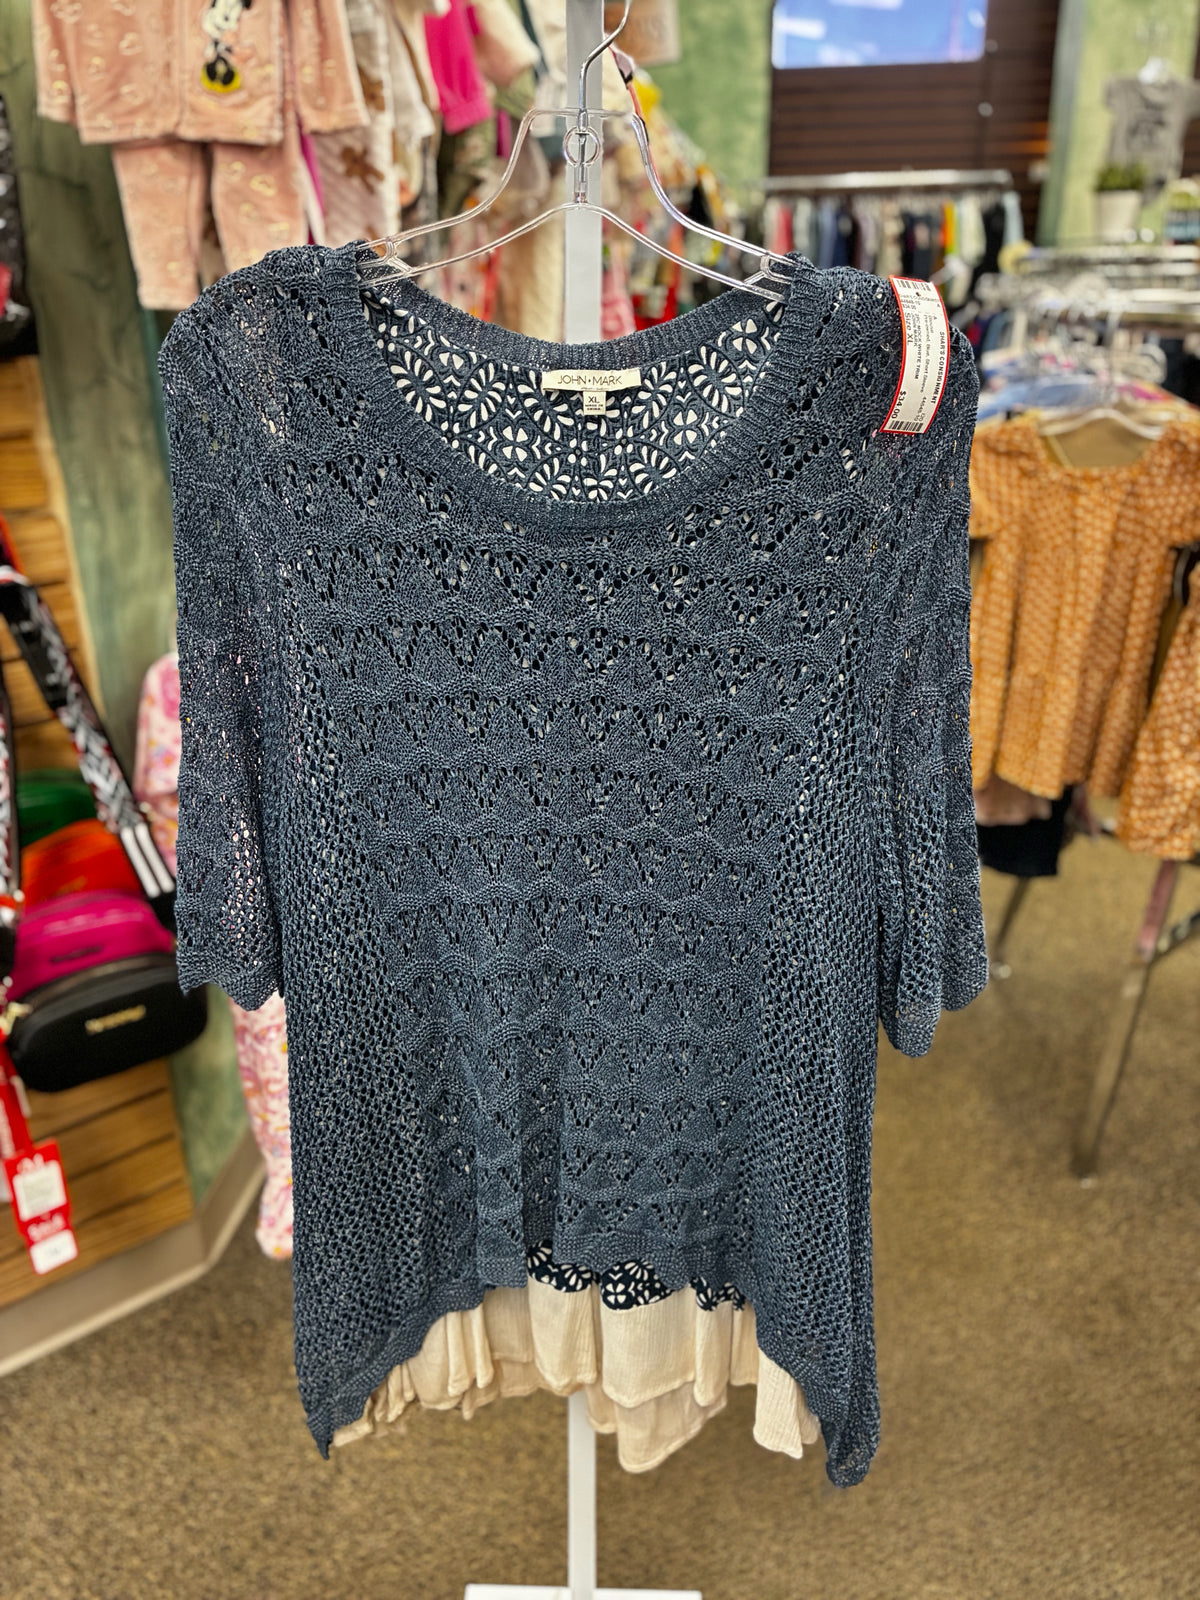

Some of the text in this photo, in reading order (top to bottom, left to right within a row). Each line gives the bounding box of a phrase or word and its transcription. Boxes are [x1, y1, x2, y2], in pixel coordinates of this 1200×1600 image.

[904, 312, 914, 346] Size XL
[931, 357, 945, 404] CONSIGNMENT
[892, 391, 906, 418] $34.00
